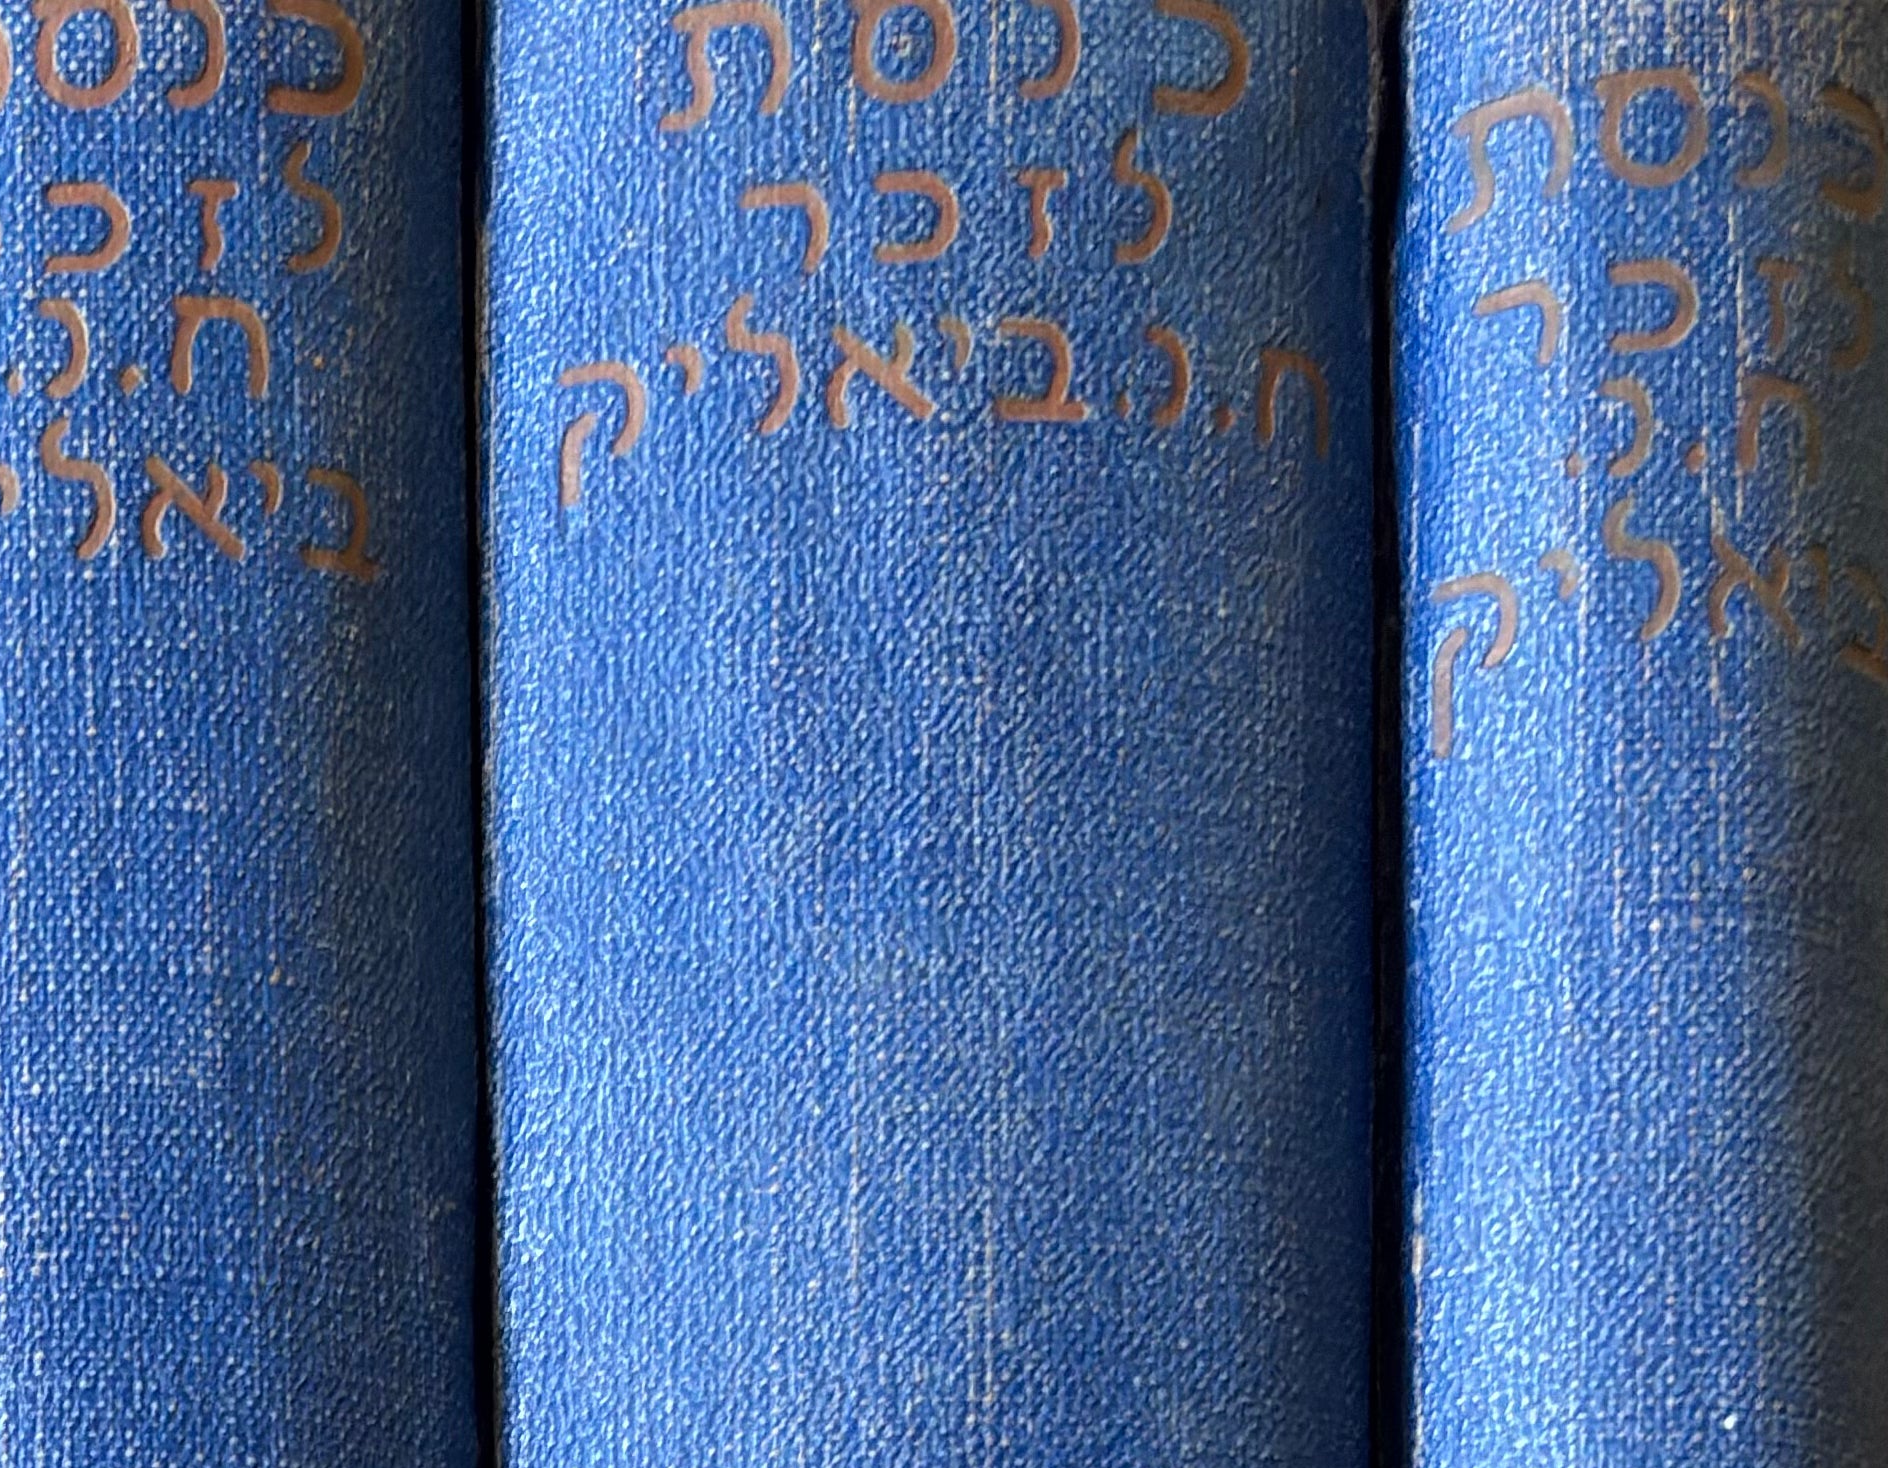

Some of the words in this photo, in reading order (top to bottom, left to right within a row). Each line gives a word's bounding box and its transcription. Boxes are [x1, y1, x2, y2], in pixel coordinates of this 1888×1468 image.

[658, 0, 1252, 135] כנסת
[740, 128, 1173, 274] לזכר
[1446, 68, 1888, 236] כנסת
[6, 295, 271, 398] ח.נ.
[1474, 245, 1875, 371] לזכר
